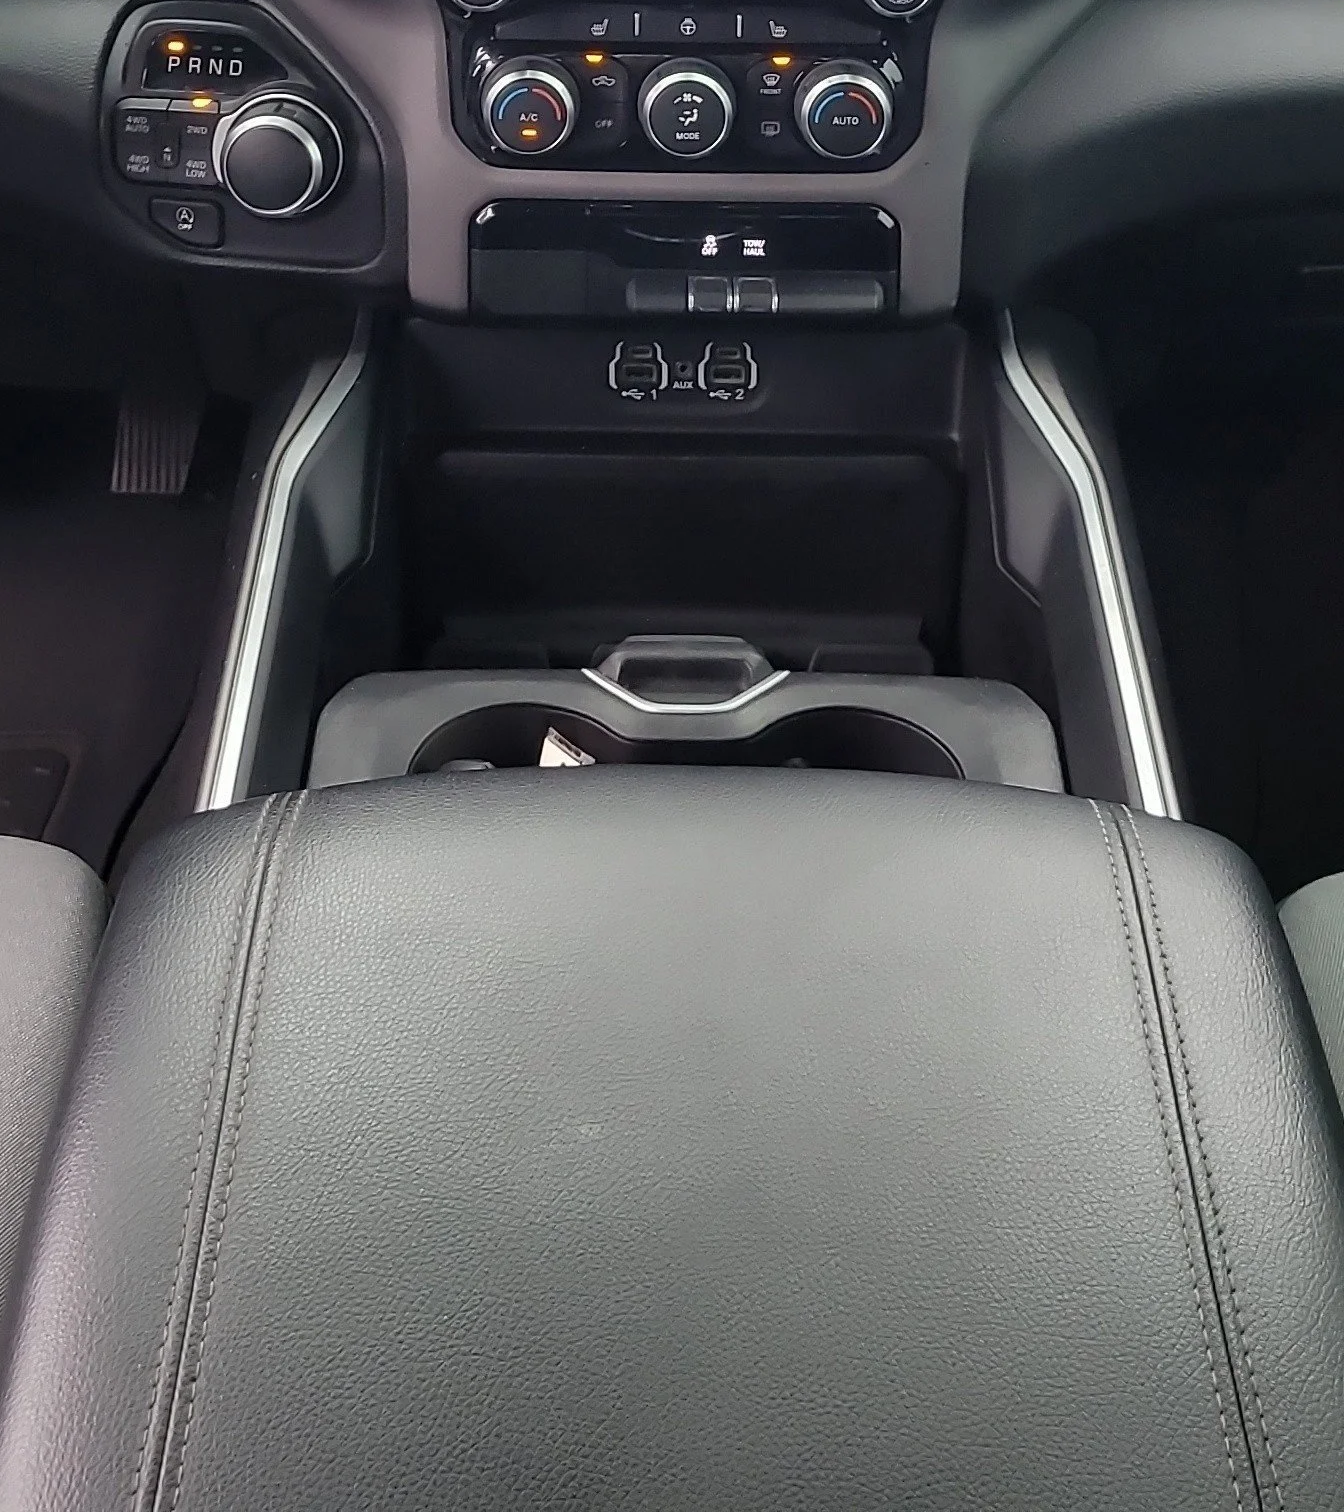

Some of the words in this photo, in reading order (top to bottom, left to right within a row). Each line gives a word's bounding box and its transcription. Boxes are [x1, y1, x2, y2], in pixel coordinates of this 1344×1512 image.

[126, 115, 148, 125] 4WD
[519, 113, 539, 122] A/C
[832, 116, 860, 125] AUTO
[676, 132, 701, 140] MODE
[185, 168, 207, 178] LOW
[701, 247, 718, 256] OFF
[743, 247, 766, 256] HAUL
[672, 381, 694, 389] AUX
[650, 389, 657, 400] 1
[735, 389, 745, 400] 2
